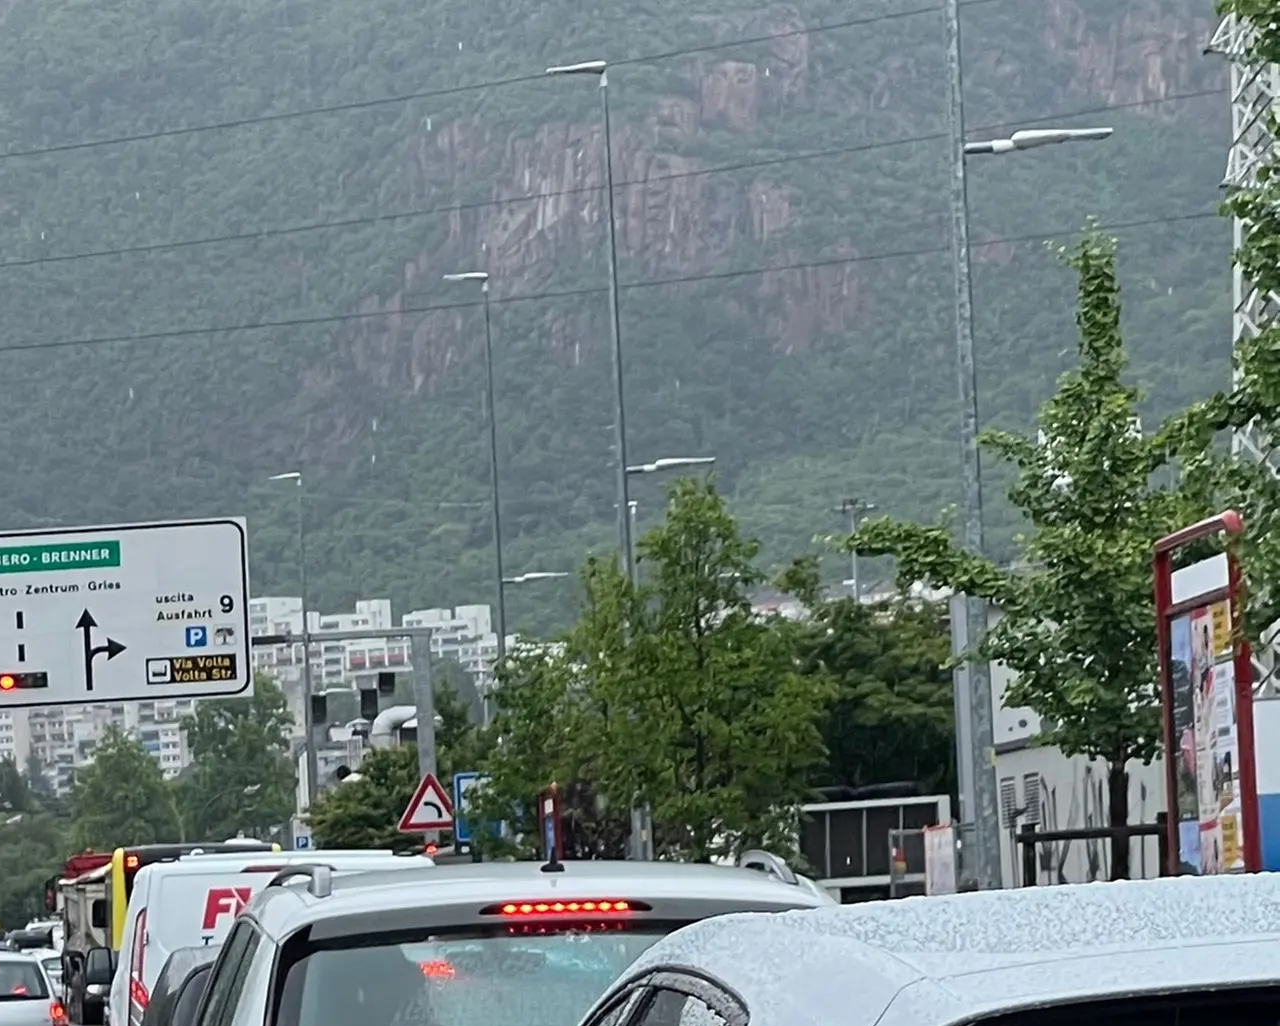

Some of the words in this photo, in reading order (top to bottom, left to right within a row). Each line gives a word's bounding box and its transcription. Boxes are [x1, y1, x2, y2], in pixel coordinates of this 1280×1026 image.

[41, 548, 110, 564] BRENNER
[25, 583, 79, 596] Zentrum
[88, 580, 121, 591] Gries
[155, 592, 194, 604] uscita
[220, 595, 234, 613] 9
[156, 609, 213, 621] Ausfahrt
[173, 658, 193, 669] Via
[197, 656, 231, 668] Volta
[174, 669, 207, 681] Volta
